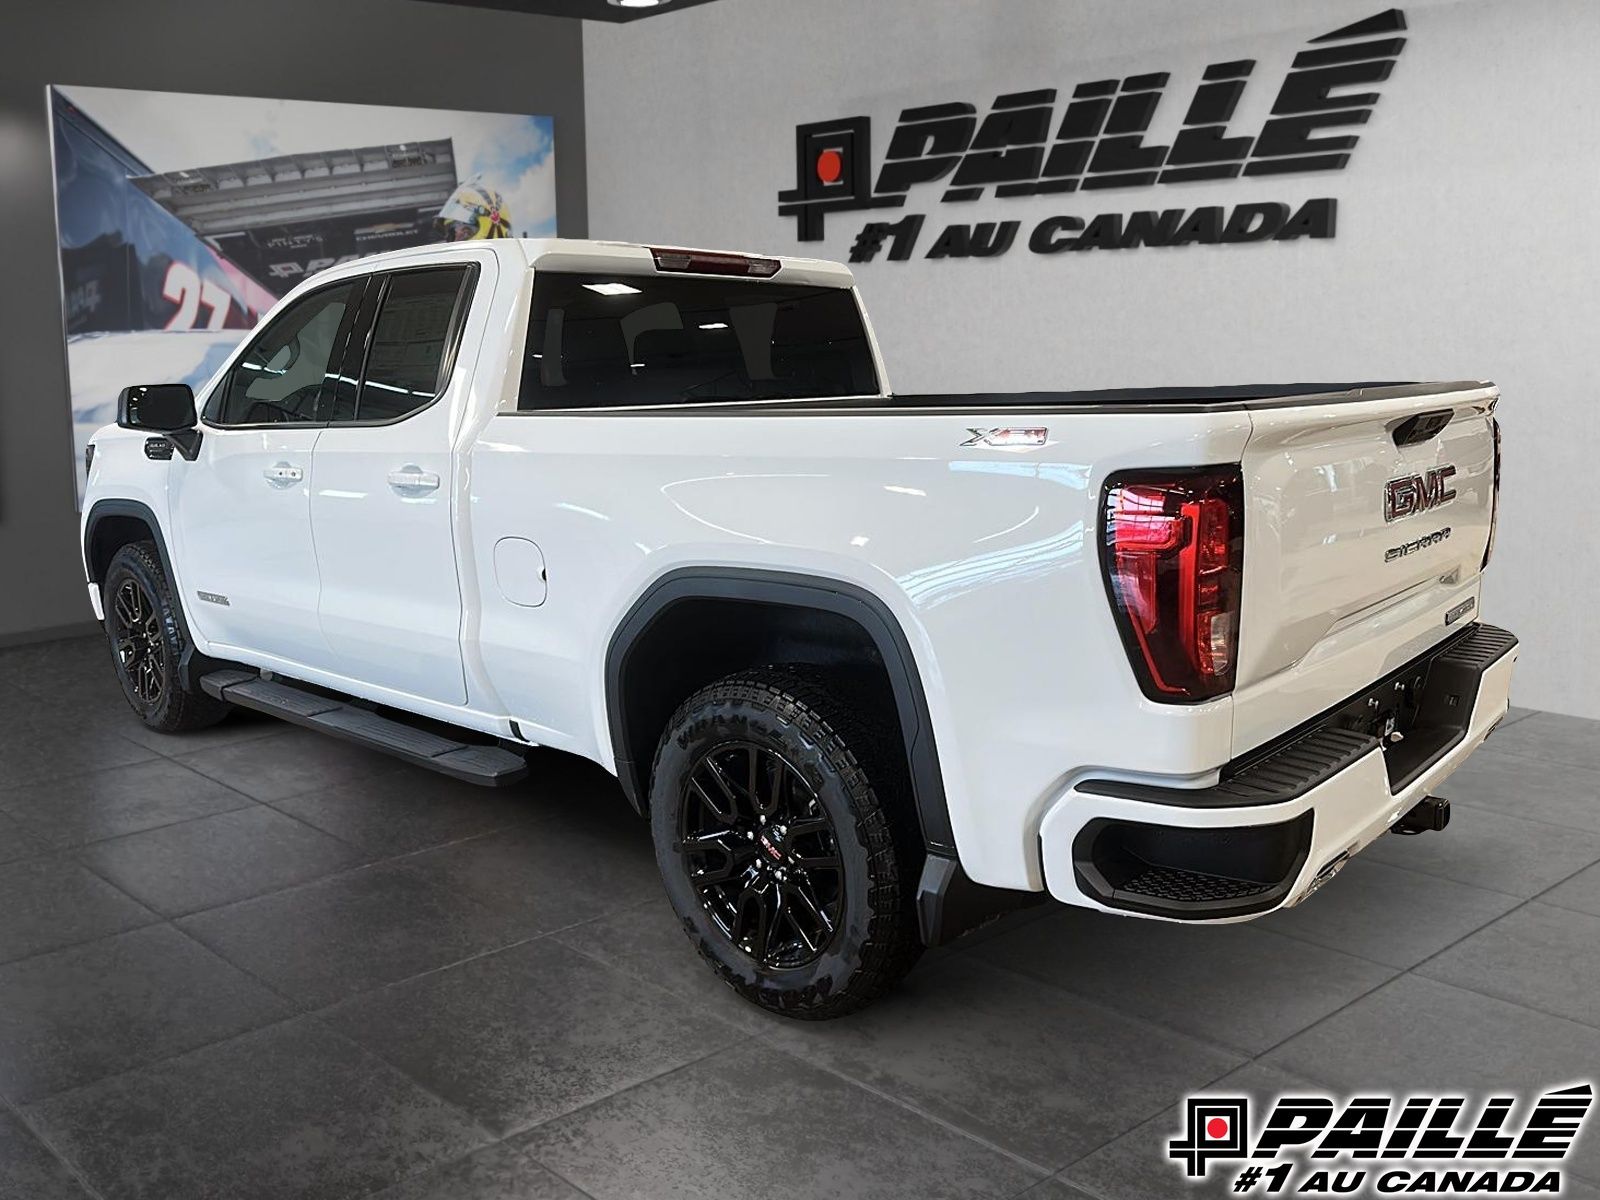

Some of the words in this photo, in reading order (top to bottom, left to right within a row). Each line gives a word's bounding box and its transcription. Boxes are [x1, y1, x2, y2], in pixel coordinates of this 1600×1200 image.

[874, 8, 1407, 202] PAILLÉ
[849, 214, 925, 262] #1
[925, 220, 1021, 259] AU
[1028, 198, 1337, 254] CANADA
[163, 260, 231, 331] 27
[1384, 464, 1456, 522] GMC
[760, 835, 782, 860] GMC
